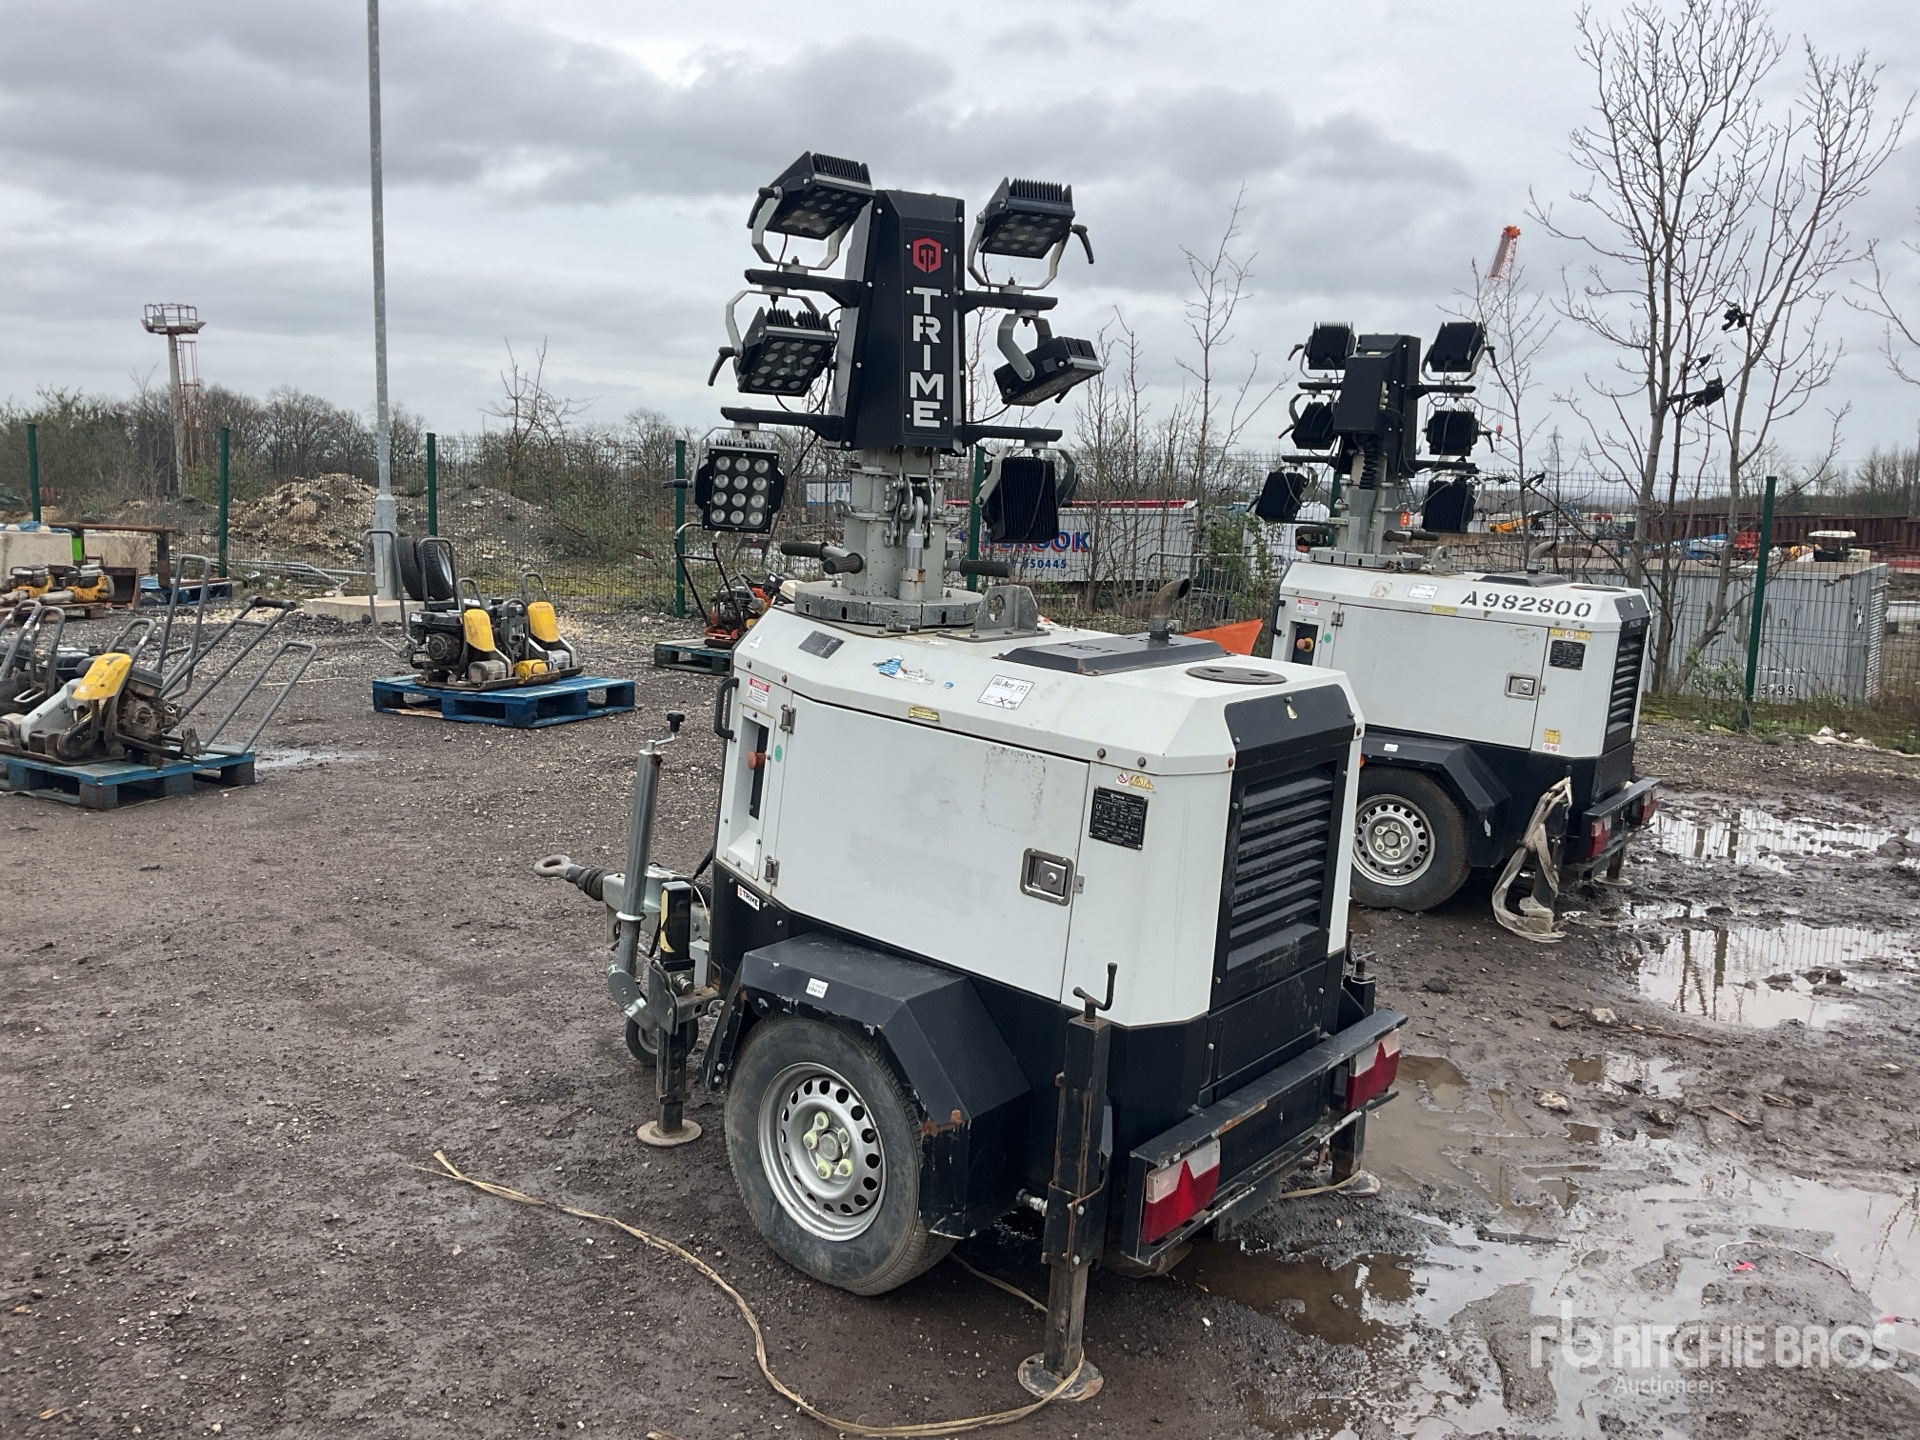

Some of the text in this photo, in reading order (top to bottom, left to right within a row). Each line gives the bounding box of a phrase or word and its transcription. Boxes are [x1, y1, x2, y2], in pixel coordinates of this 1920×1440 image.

[909, 286, 945, 428] TRIME
[1460, 591, 1592, 617] A982800
[742, 889, 759, 908] TRIME
